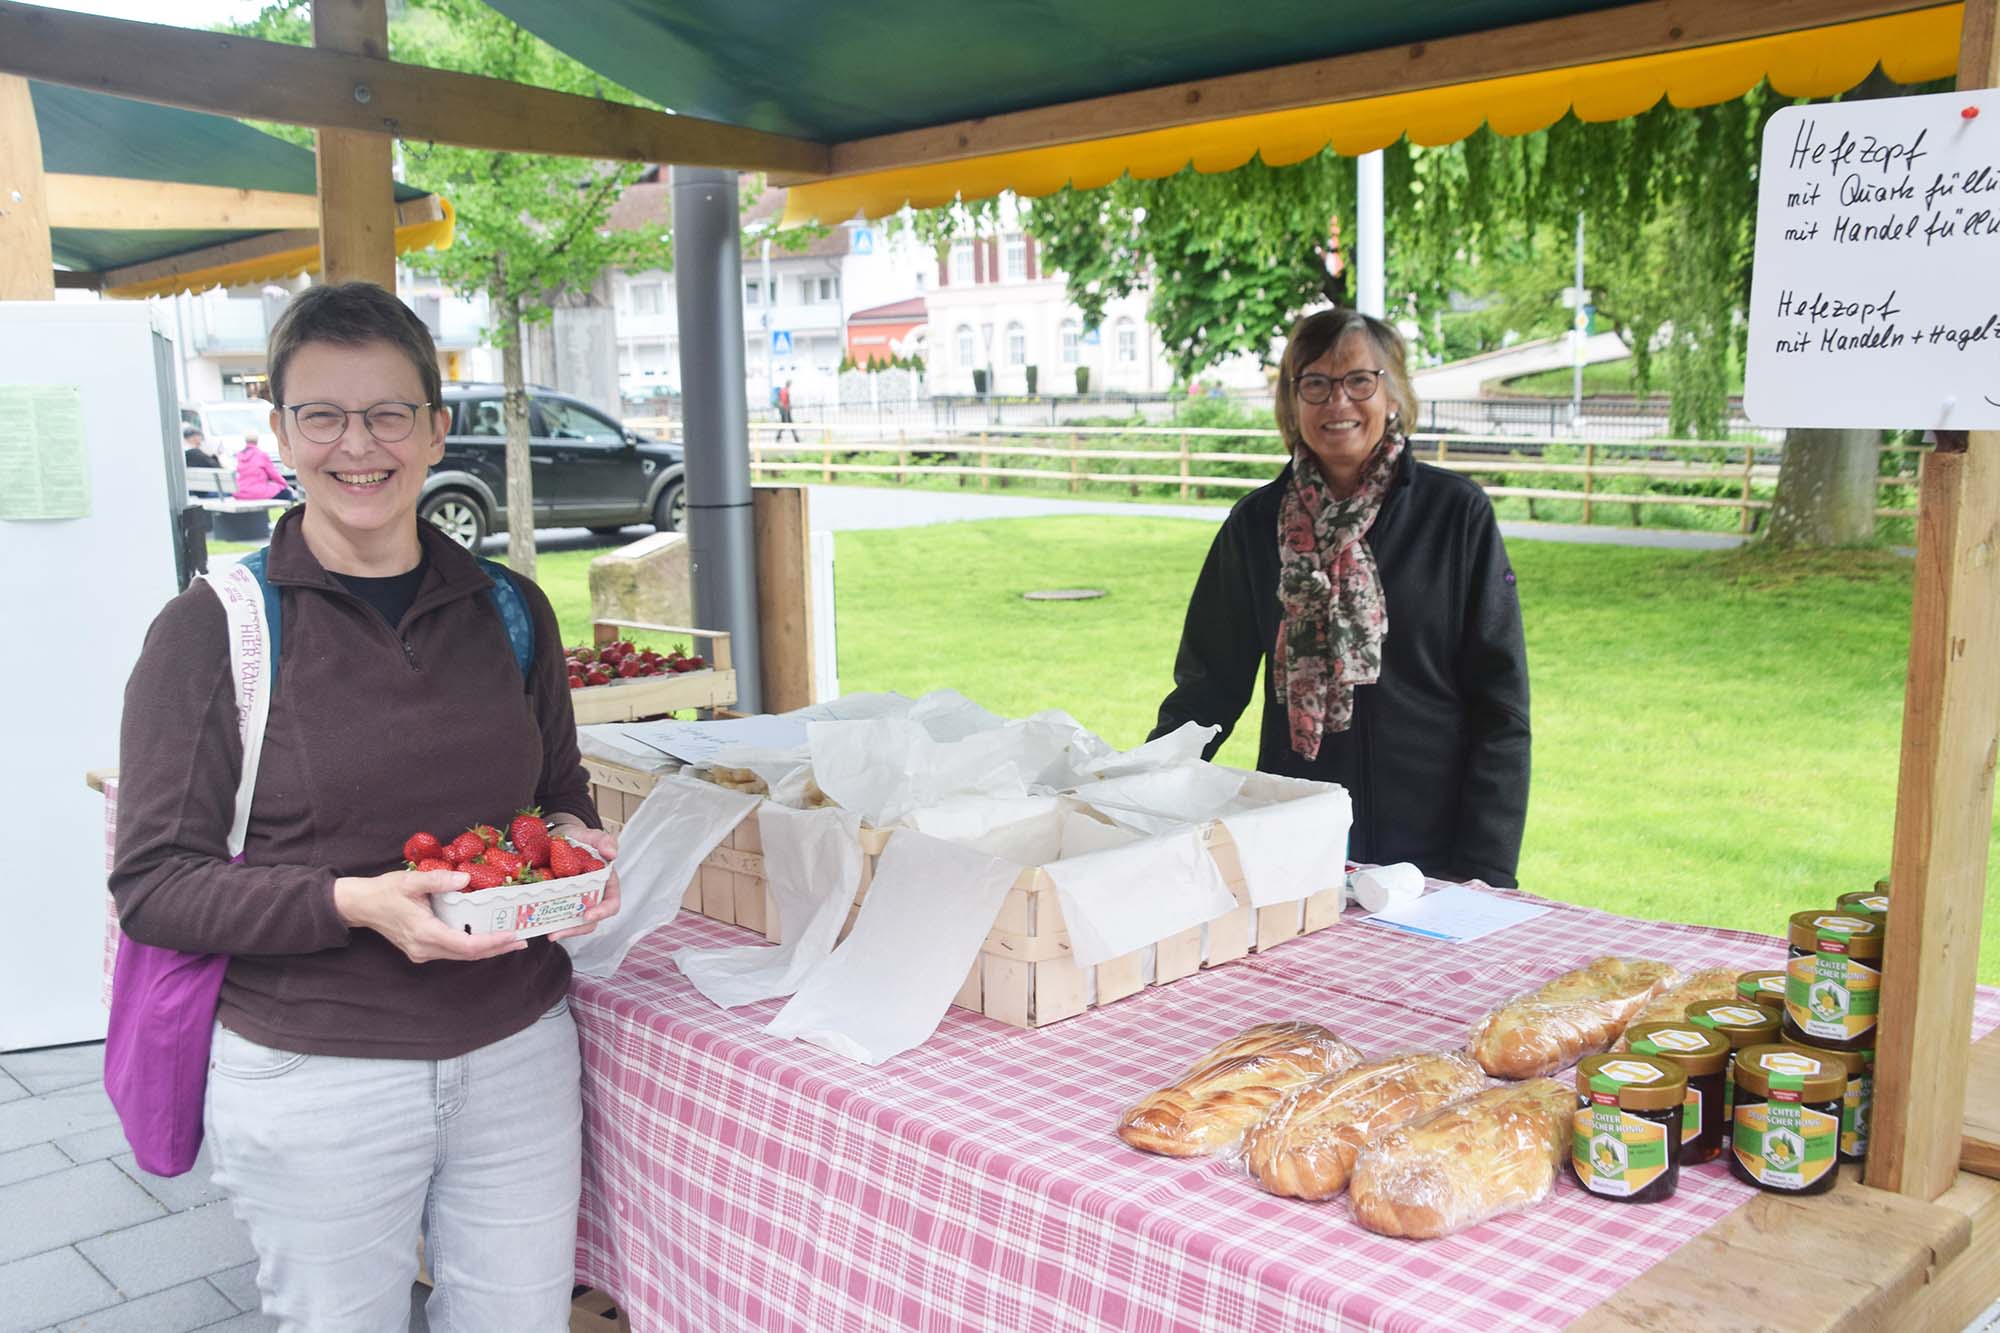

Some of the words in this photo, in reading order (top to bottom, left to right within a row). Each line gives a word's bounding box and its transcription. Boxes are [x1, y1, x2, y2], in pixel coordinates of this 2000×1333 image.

[1789, 119, 1928, 176] Hefezopf
[1787, 182, 1821, 207] mit
[1785, 221, 1819, 241] mit
[1777, 289, 1900, 324] Hefezopf
[1776, 332, 1811, 353] mit
[240, 624, 255, 657] HIER
